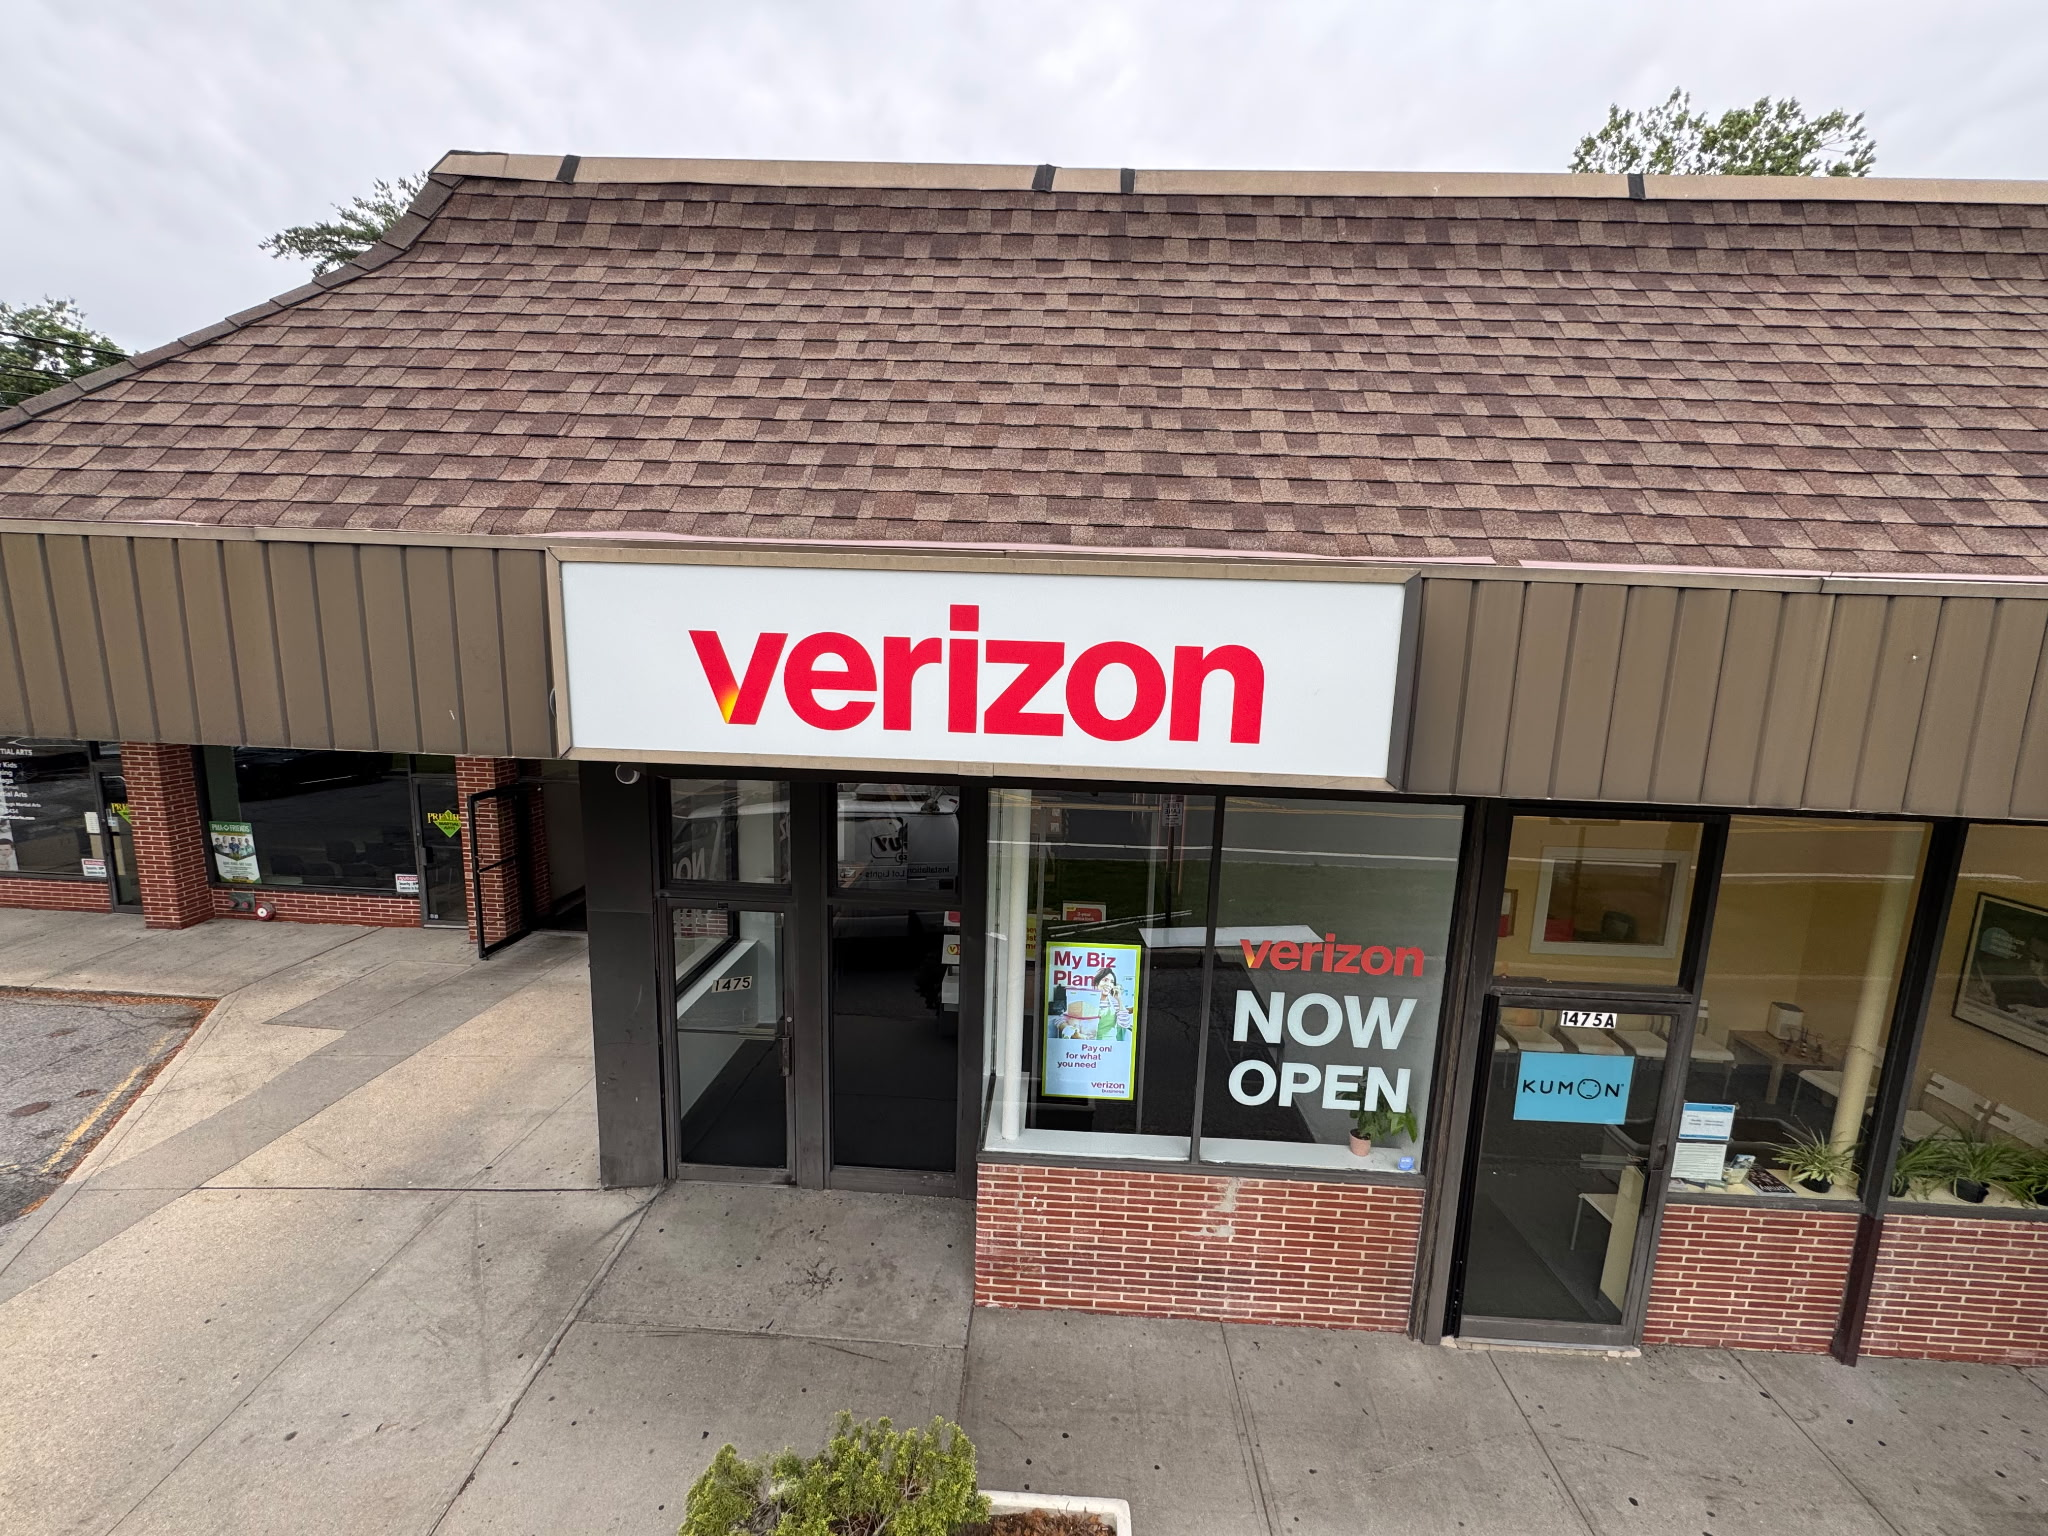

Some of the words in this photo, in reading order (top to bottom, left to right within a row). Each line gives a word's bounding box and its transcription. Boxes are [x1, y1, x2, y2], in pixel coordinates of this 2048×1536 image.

[688, 603, 1259, 744] verizon
[229, 825, 250, 833] FRIENDS
[1054, 950, 1083, 970] My
[1086, 951, 1116, 969] Biz
[1240, 933, 1425, 977] verizon
[714, 976, 751, 992] 1475
[1053, 970, 1097, 987] Plan
[1233, 989, 1418, 1050] NOW
[1562, 1011, 1615, 1028] 1475A
[1066, 1051, 1079, 1060] for
[1079, 1052, 1102, 1061] what
[1081, 1043, 1098, 1053] Pay
[1057, 1061, 1074, 1069] you
[1074, 1061, 1097, 1069] need
[1091, 1081, 1125, 1090] verizon
[1228, 1059, 1411, 1114] OPEN
[1522, 1078, 1625, 1100] KUMON
